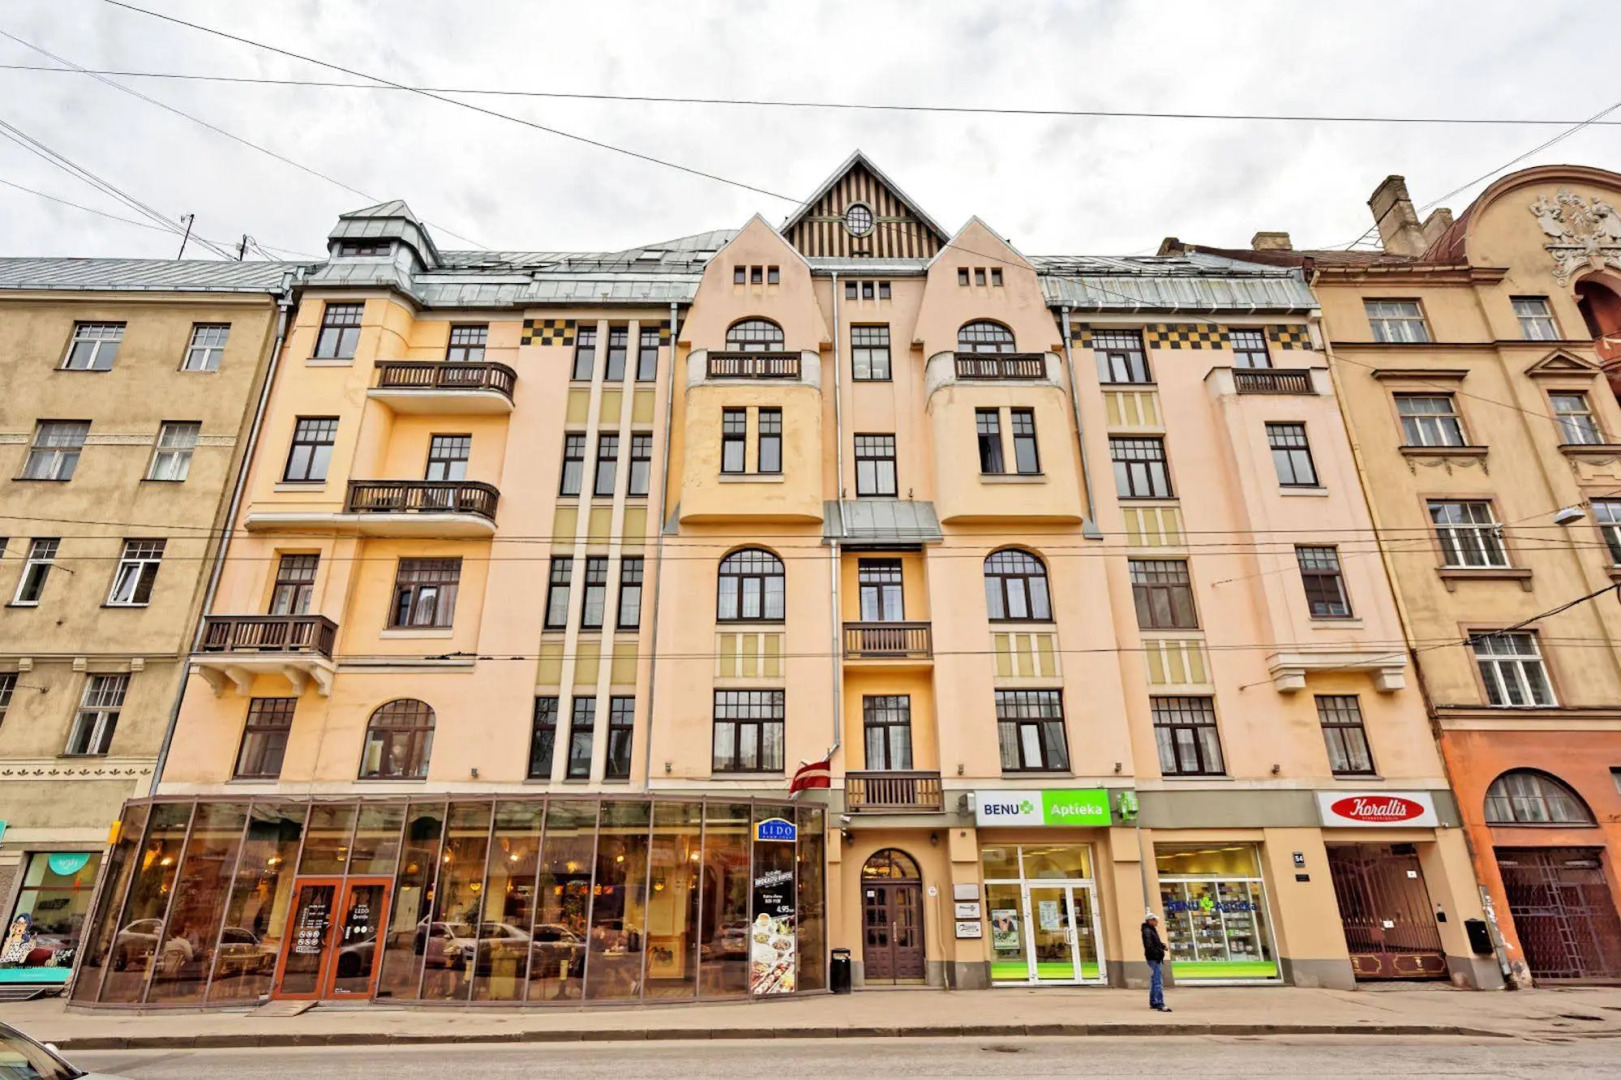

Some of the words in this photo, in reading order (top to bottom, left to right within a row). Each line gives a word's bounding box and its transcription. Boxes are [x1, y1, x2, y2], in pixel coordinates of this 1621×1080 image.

[984, 804, 1019, 815] BENU
[1050, 803, 1103, 817] Aptieka
[1350, 798, 1406, 816] Korallis
[762, 825, 792, 835] LIDO
